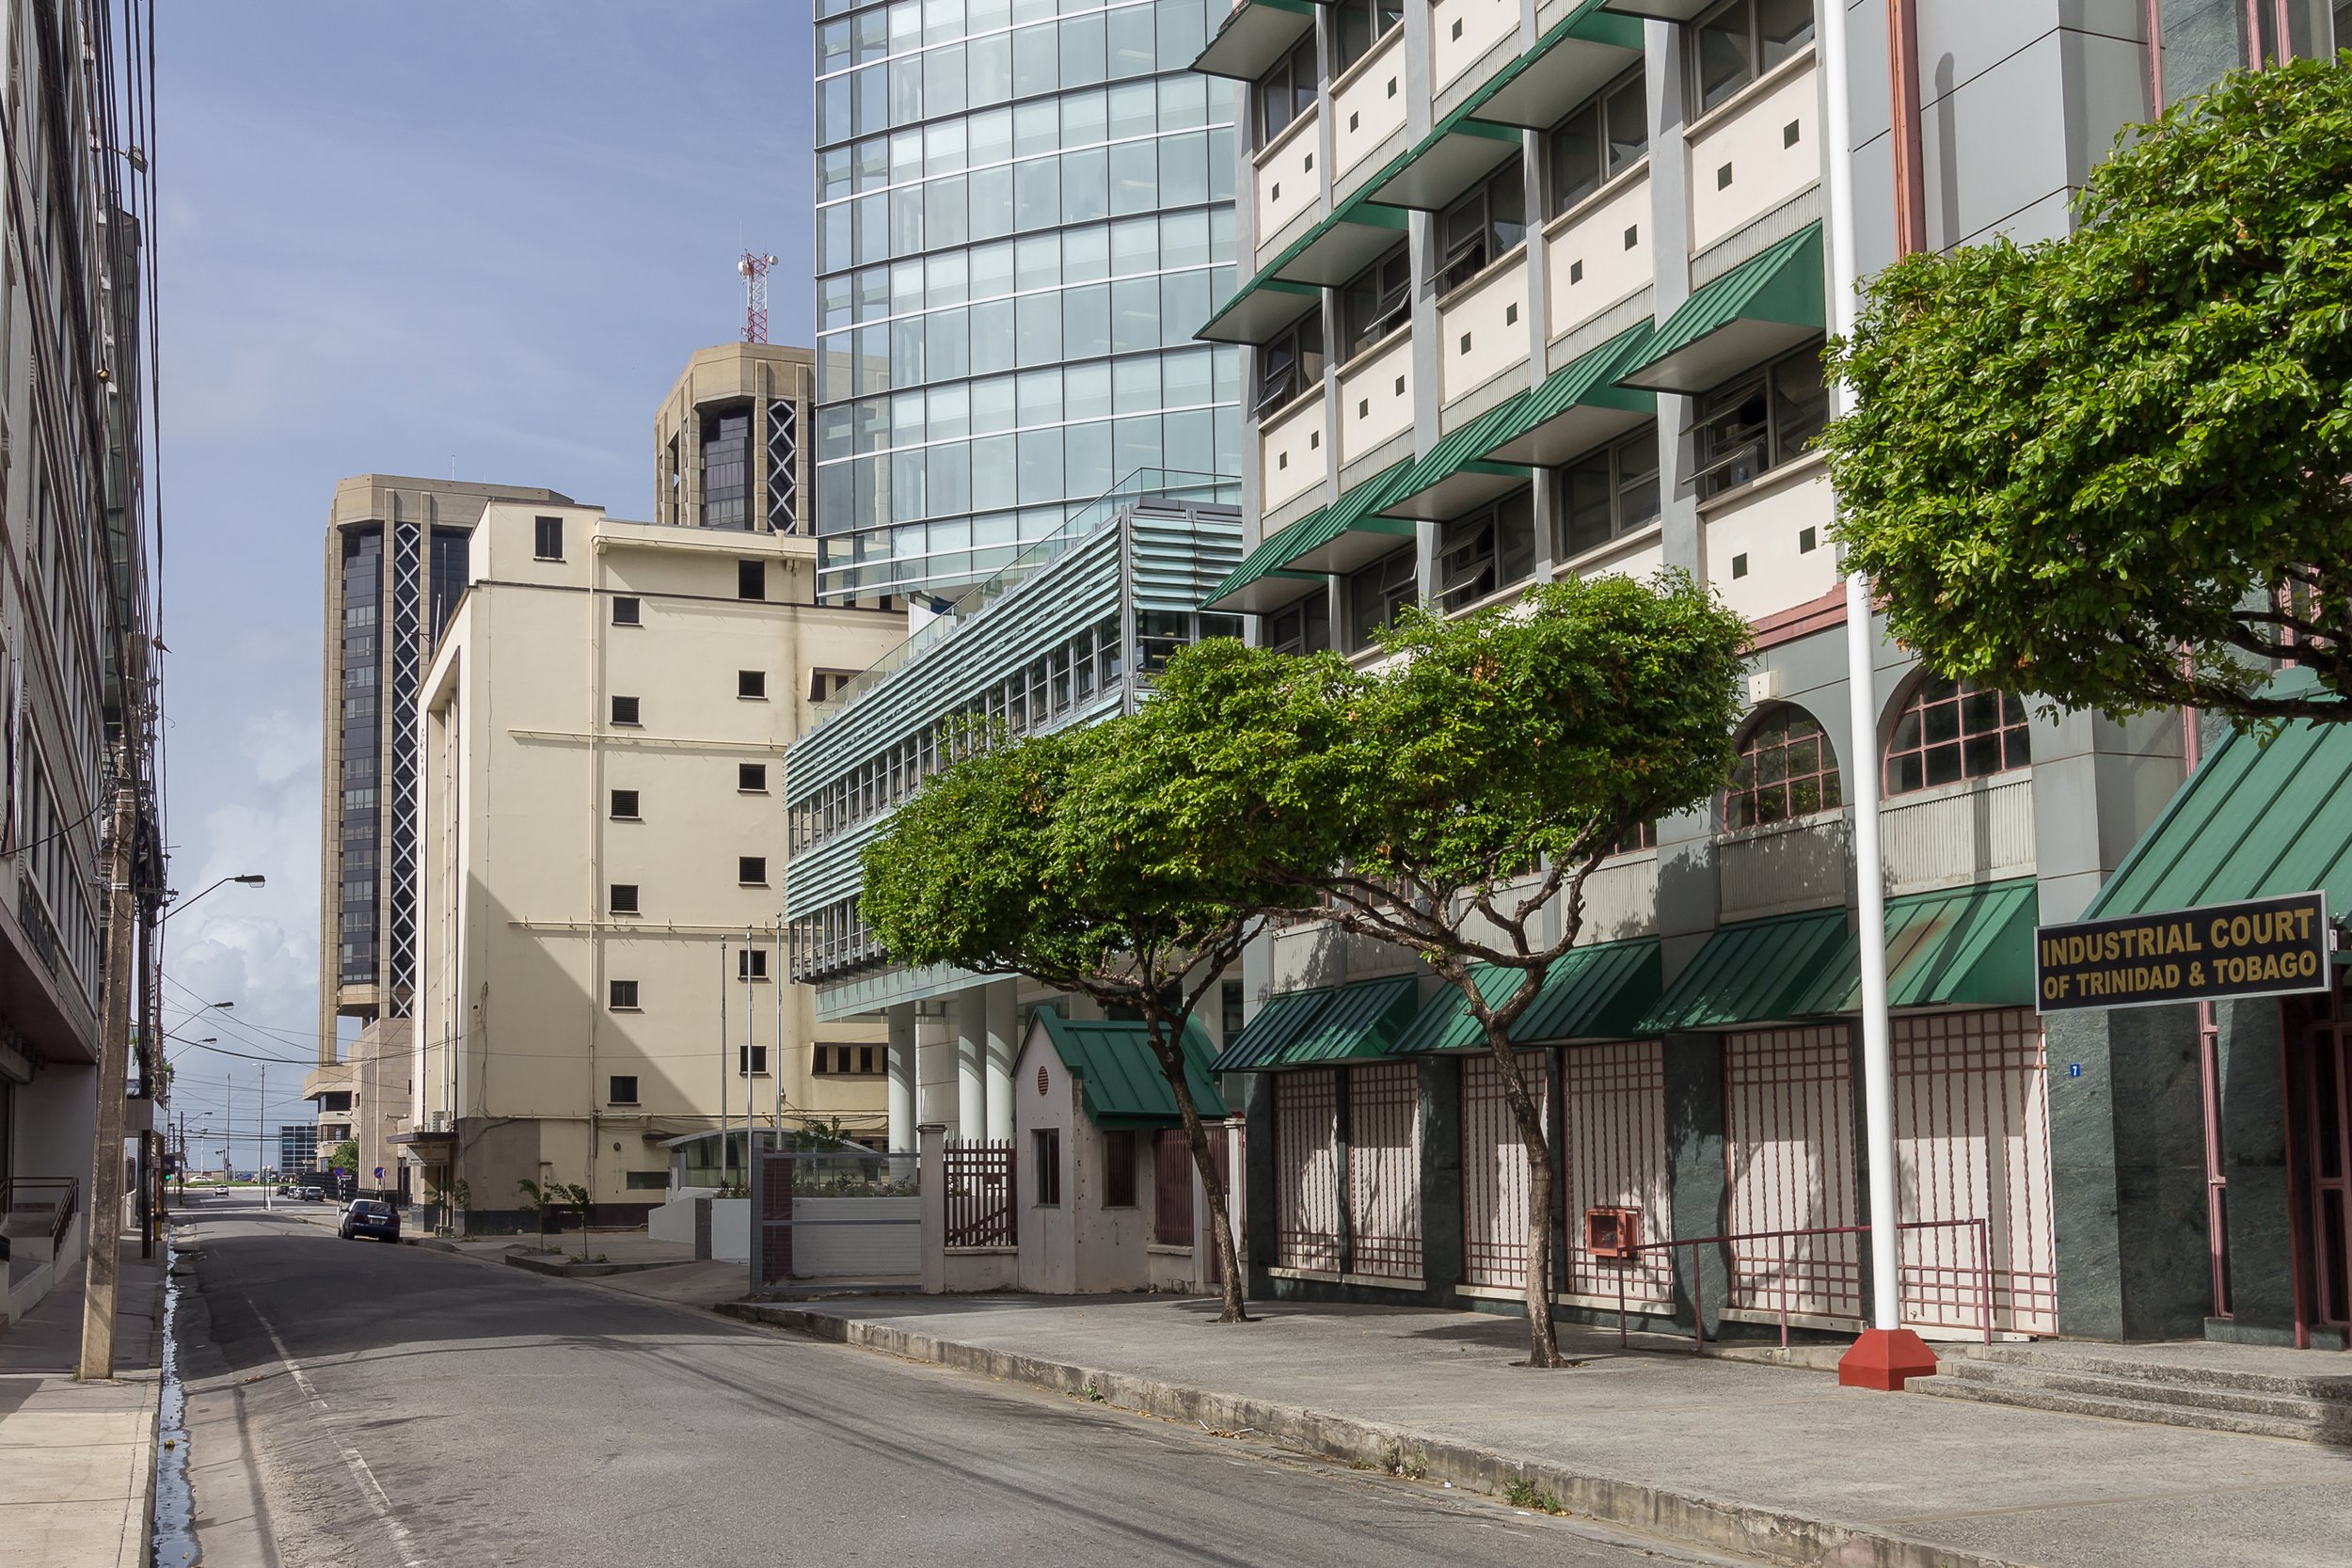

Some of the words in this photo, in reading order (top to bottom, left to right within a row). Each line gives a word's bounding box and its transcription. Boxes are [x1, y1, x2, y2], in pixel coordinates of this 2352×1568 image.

[2042, 922, 2202, 967] INDUSTRIAL
[2211, 908, 2315, 949] COURT
[2043, 974, 2070, 1000] OF
[2076, 963, 2181, 996] TRINIDAD
[2188, 961, 2205, 986] &
[2213, 950, 2316, 984] TOBAGO
